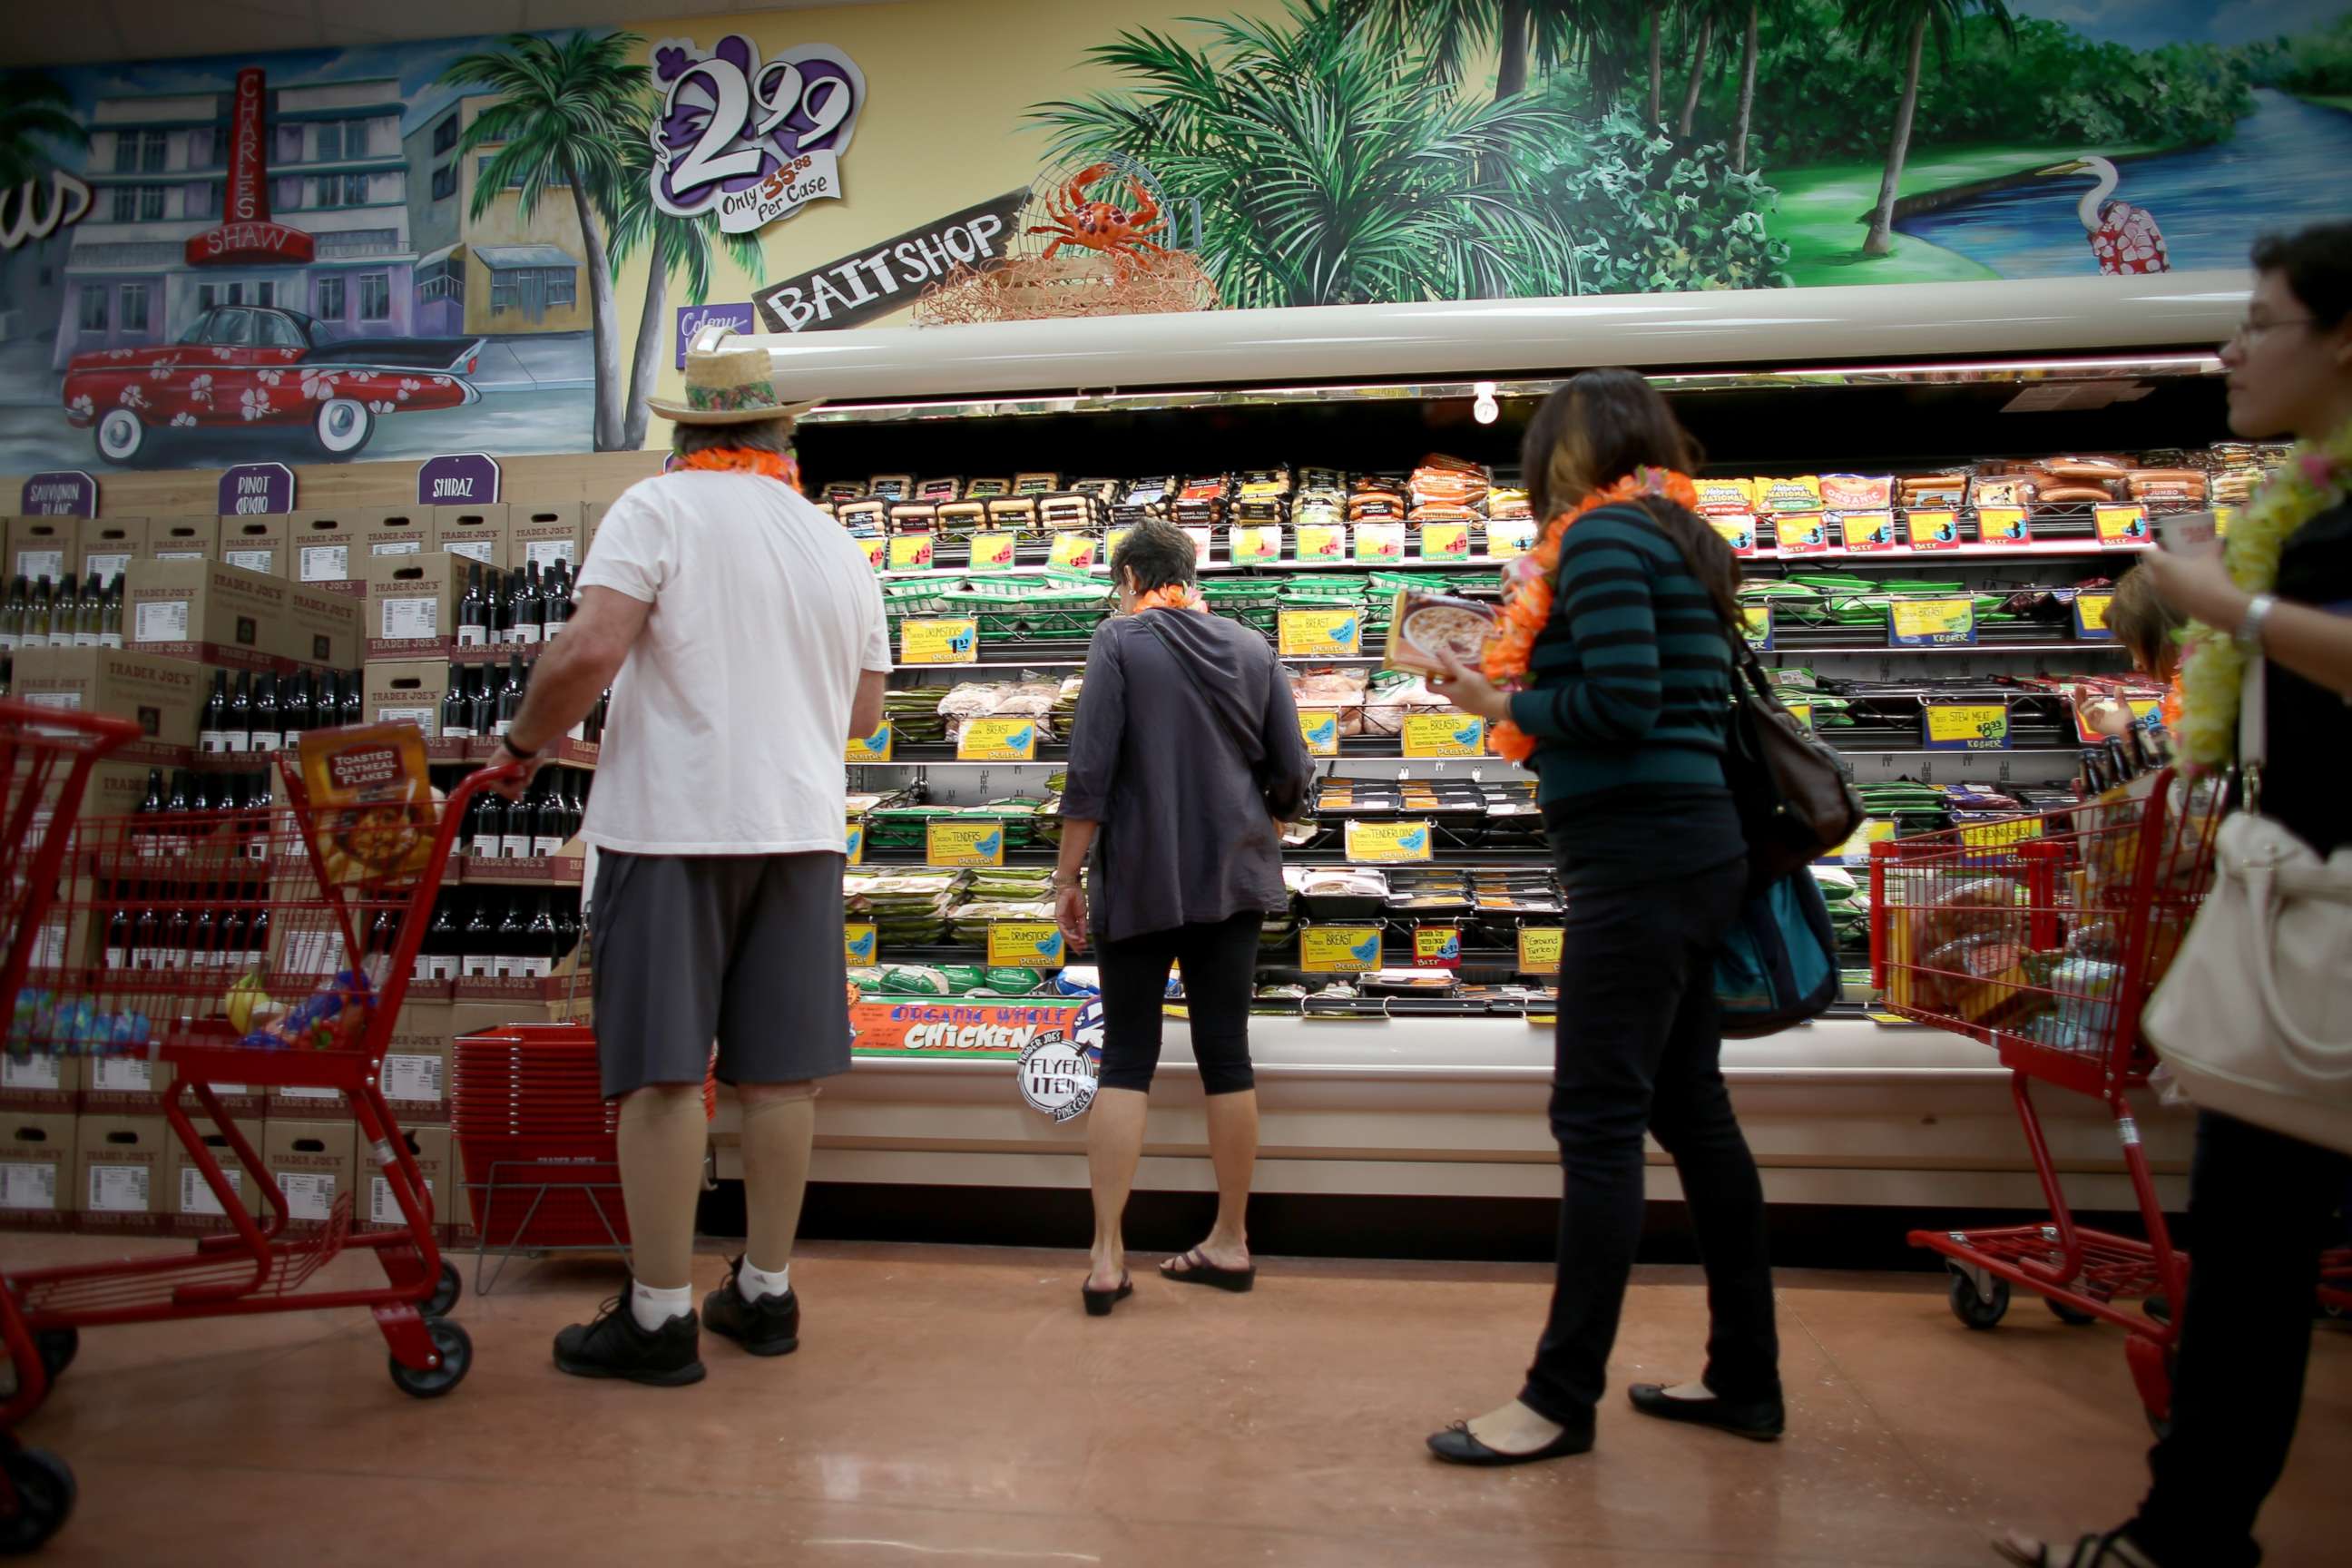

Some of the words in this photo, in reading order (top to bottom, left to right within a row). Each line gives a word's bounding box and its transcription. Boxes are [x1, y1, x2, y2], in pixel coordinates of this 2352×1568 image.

[236, 74, 259, 220] CHARLES
[722, 187, 758, 215] Only
[758, 198, 784, 222] Per
[787, 176, 828, 202] Case
[207, 225, 290, 255] SHAW
[767, 249, 900, 333] BAIT
[895, 213, 1003, 284] SHOP
[238, 475, 270, 494] PINOT
[432, 477, 474, 497] SHIRAZ
[30, 482, 80, 503] SAUVIGNON
[1767, 490, 1815, 499] NATIONAL
[1826, 488, 1880, 503] ORGANIC
[1699, 493, 1749, 504] NATIONAL
[368, 531, 398, 541] TRADER
[400, 530, 426, 539] JOE'S
[441, 531, 472, 540] TRADER
[474, 530, 499, 539] JOE'S
[515, 527, 546, 537] TRADER
[548, 525, 573, 535] JOE'S
[296, 534, 328, 544] TRADER
[329, 533, 353, 543] JOE'S
[214, 573, 254, 593] TRADER
[375, 582, 410, 592] TRADER
[412, 580, 440, 591] JOE'S
[1305, 617, 1329, 628] BREAST
[925, 626, 962, 639] DRUMSTICKS
[1932, 633, 1968, 643] KOSHER
[166, 642, 194, 652] JOE'S
[372, 639, 410, 650] TRADER
[412, 638, 441, 648] JOE'S
[456, 642, 495, 653] TRADER
[496, 642, 527, 652] JOE'S
[109, 662, 157, 681] TRADER
[159, 671, 191, 685] JOE'S
[372, 691, 408, 701] TRADER
[410, 691, 437, 701] JOE'S
[1950, 710, 1969, 722] STEW
[1972, 710, 1991, 720] MEAT
[986, 724, 1009, 735] BREAST
[1430, 719, 1460, 730] BREASTS
[473, 737, 502, 747] TRAD
[1967, 740, 2004, 749] KOSHER
[1437, 748, 1475, 756] POULTRY
[334, 750, 394, 767] TOASTED
[335, 760, 397, 776] OATMEAL
[343, 770, 393, 785] FLAKES
[952, 831, 982, 843] TENDERS
[1371, 828, 1415, 838] TENDERLOINS
[469, 857, 512, 867] TRADER
[514, 857, 545, 867] JOE'S
[1011, 930, 1050, 941] DRUMSTICKS
[1326, 934, 1354, 945] BREAST
[1529, 936, 1558, 946] Ground
[1526, 946, 1557, 956] Turkey
[1019, 957, 1055, 965] POULTRY
[1334, 962, 1373, 972] POULTRY
[460, 975, 499, 987] TRADER
[505, 977, 535, 989] JOE'S
[891, 1005, 986, 1024] ORGANIC
[996, 1007, 1067, 1025] WHOLE
[1017, 1034, 1044, 1065] TRADER
[1043, 1030, 1062, 1044] JOE'S
[1030, 1058, 1083, 1075] FLYER
[273, 1155, 312, 1166] TRADER
[314, 1155, 344, 1166] JOE'S
